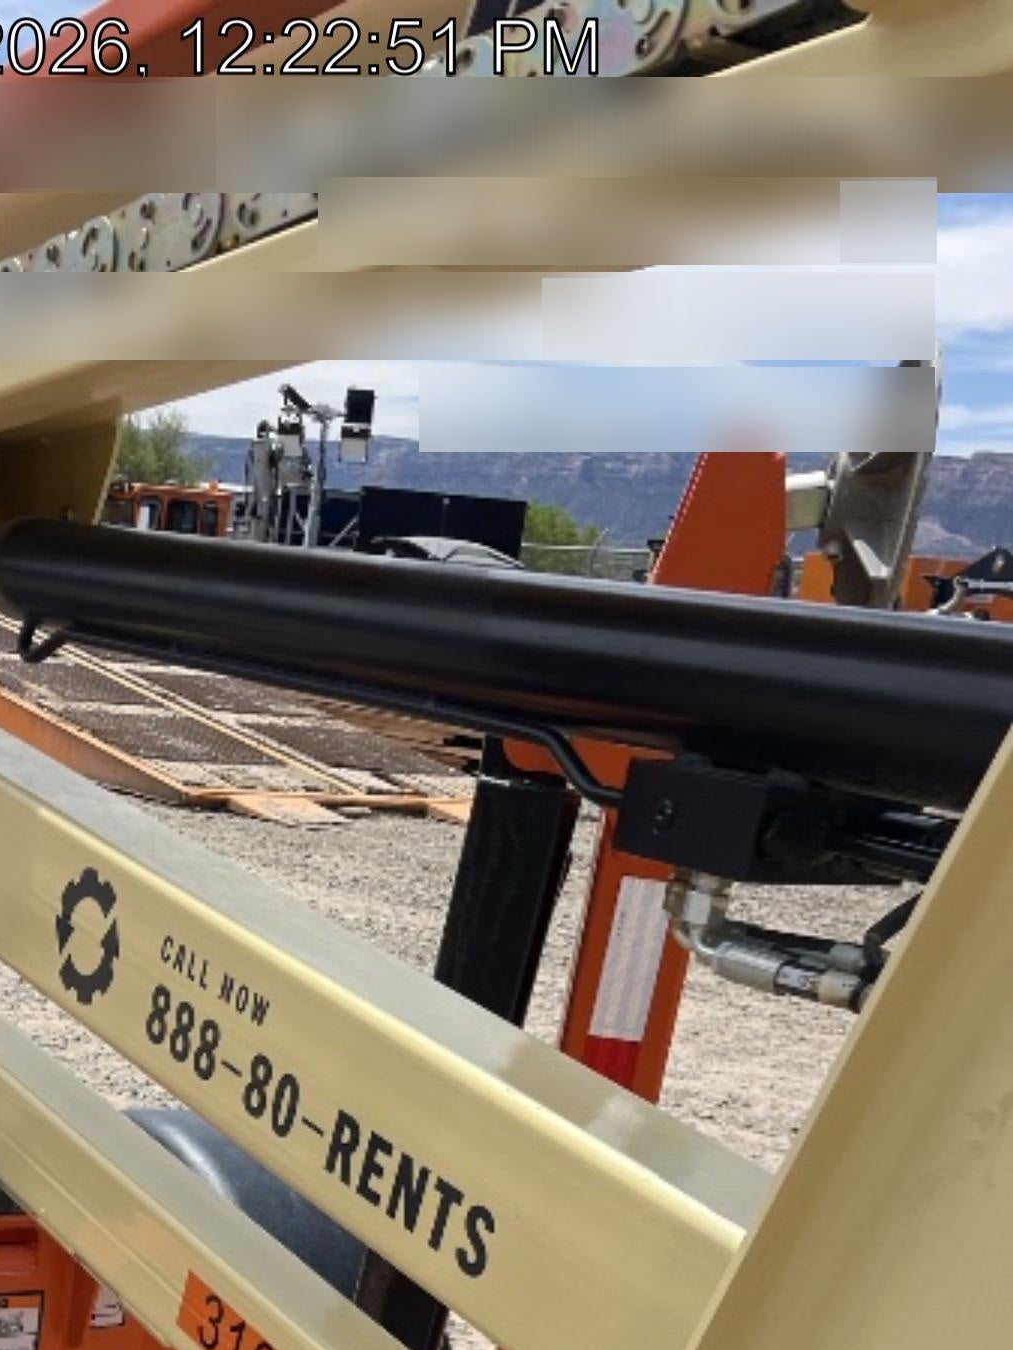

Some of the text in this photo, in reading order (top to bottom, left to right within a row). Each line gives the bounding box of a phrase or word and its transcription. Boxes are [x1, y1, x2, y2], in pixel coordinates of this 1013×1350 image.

[160, 935, 271, 1027] CALL NOW
[145, 983, 495, 1278] 888-80-RENTS
